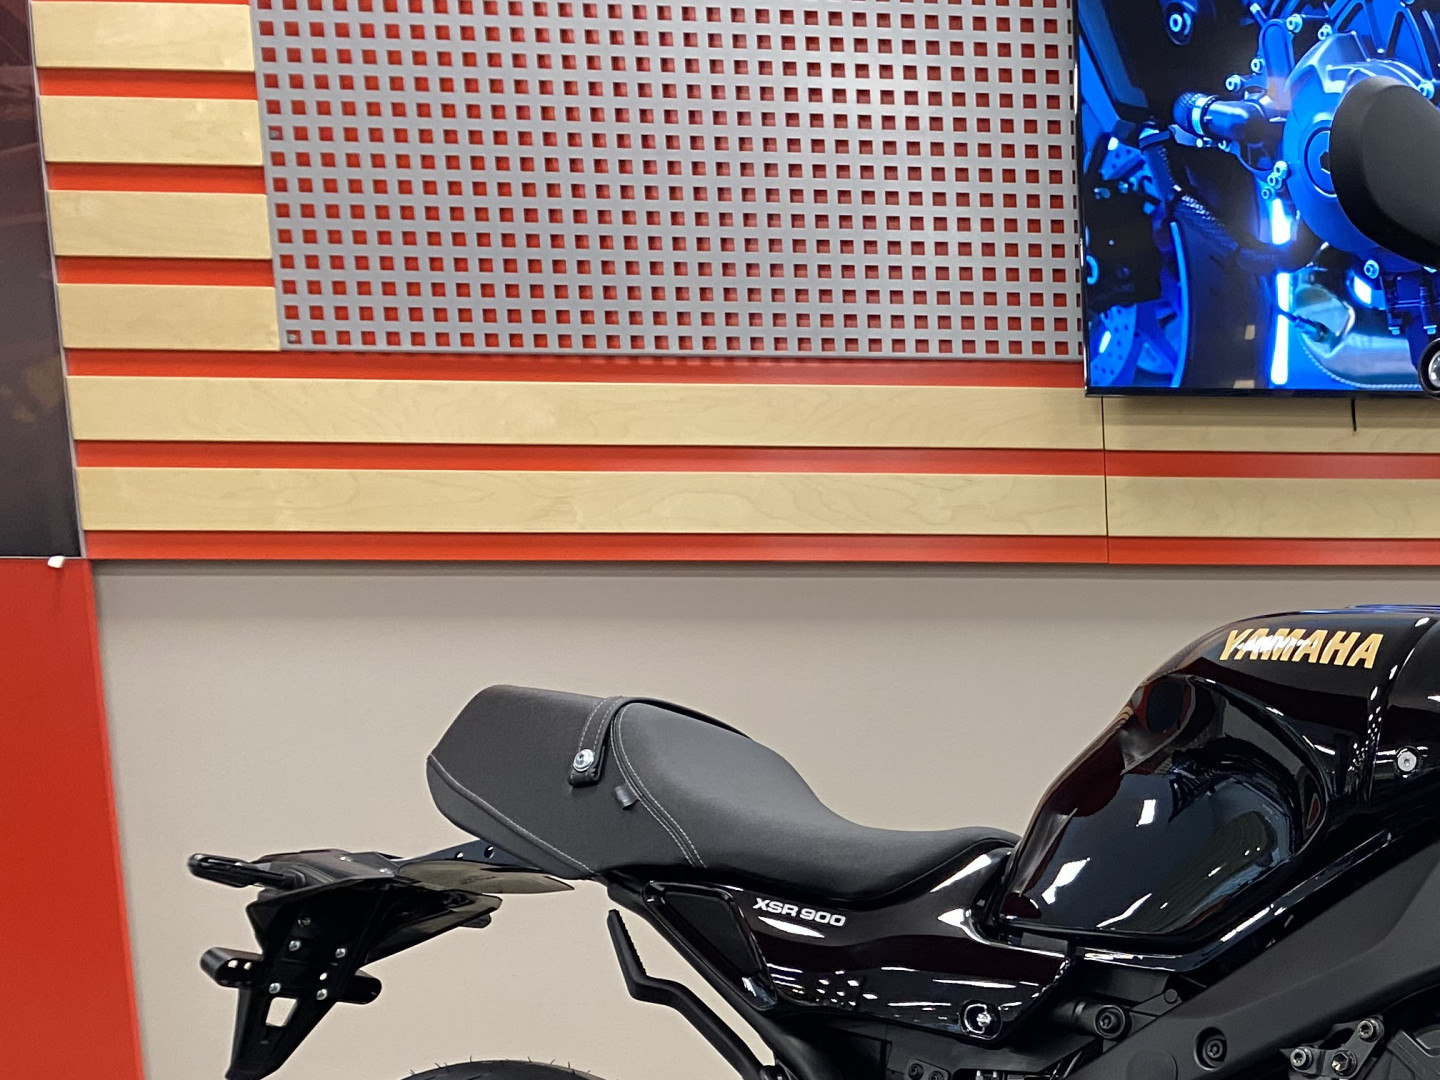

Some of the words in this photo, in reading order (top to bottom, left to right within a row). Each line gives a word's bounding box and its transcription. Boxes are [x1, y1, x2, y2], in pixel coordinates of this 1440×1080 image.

[1219, 628, 1384, 669] YAMAHA
[752, 897, 799, 917] XSR
[799, 908, 847, 927] 900
